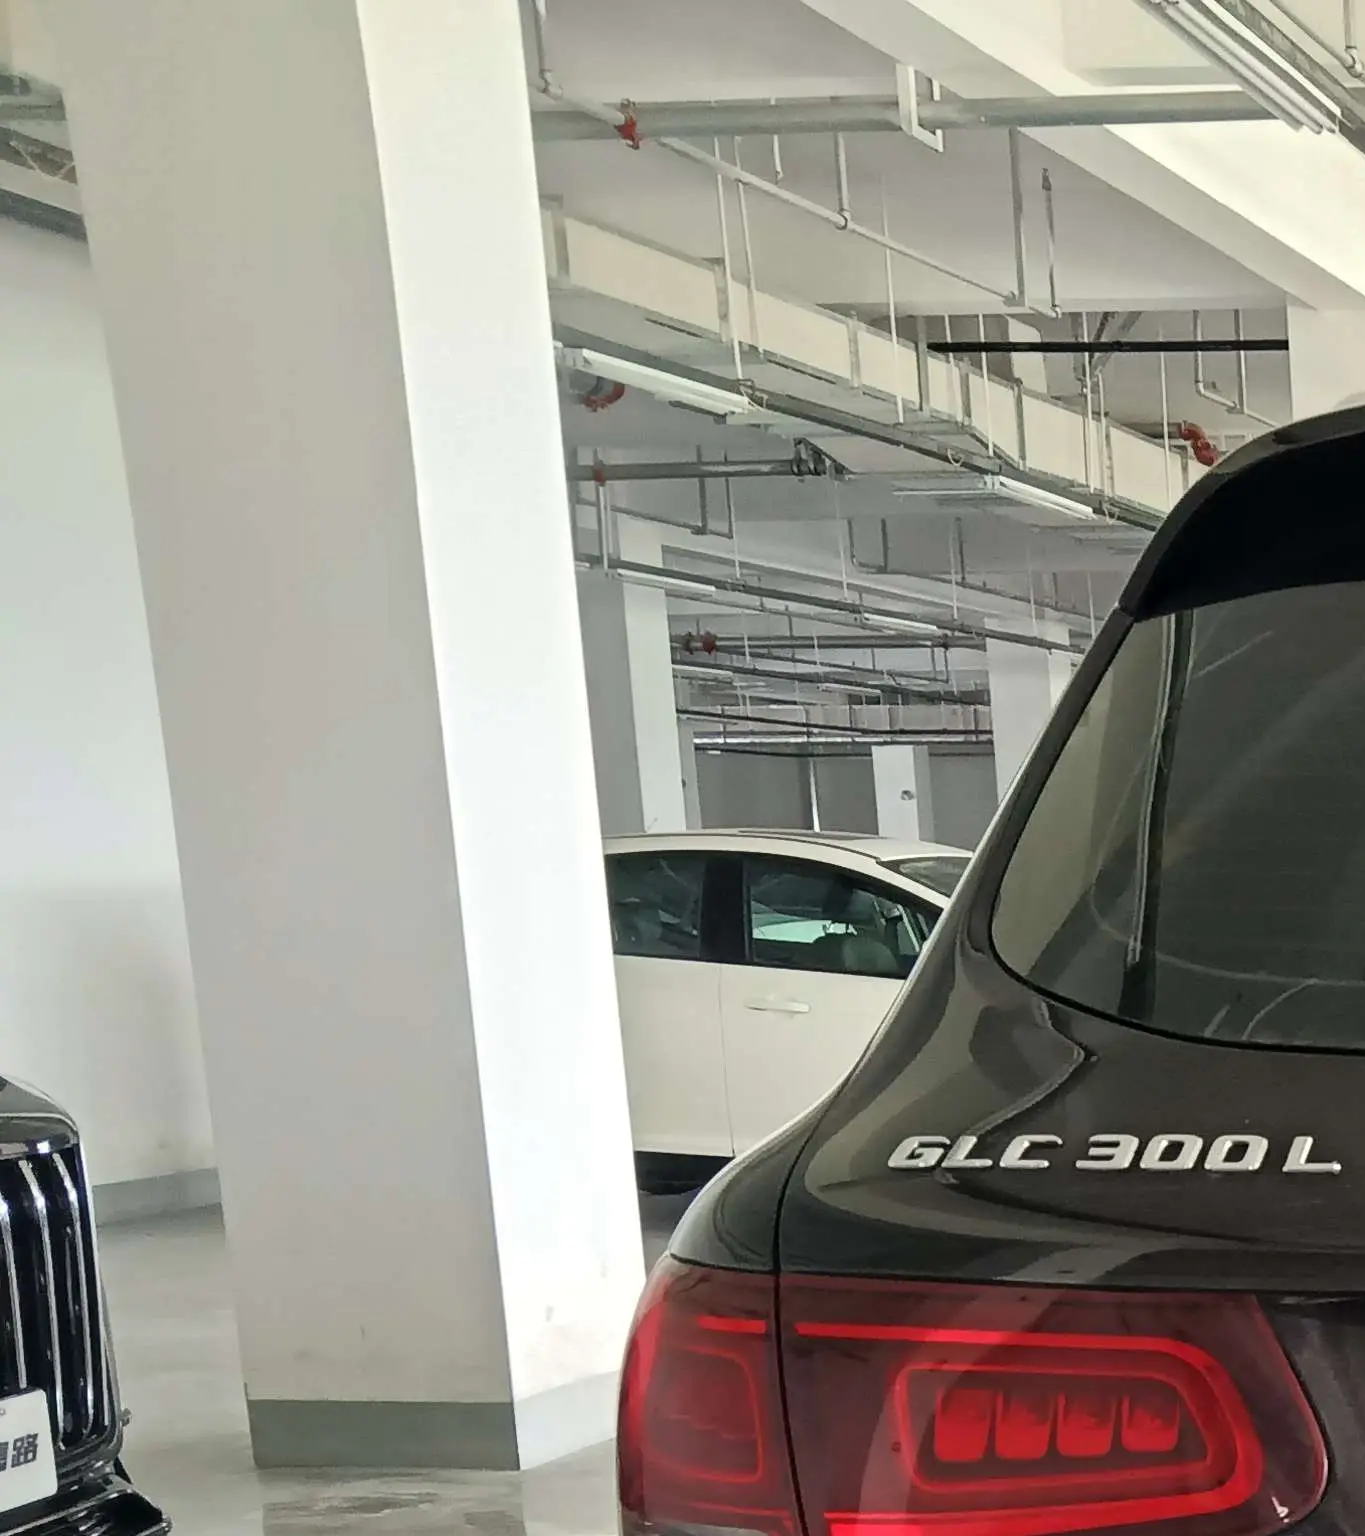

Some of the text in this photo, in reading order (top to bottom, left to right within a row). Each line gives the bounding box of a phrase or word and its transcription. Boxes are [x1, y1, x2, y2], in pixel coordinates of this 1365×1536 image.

[887, 1133, 1341, 1173] GLC 300 L
